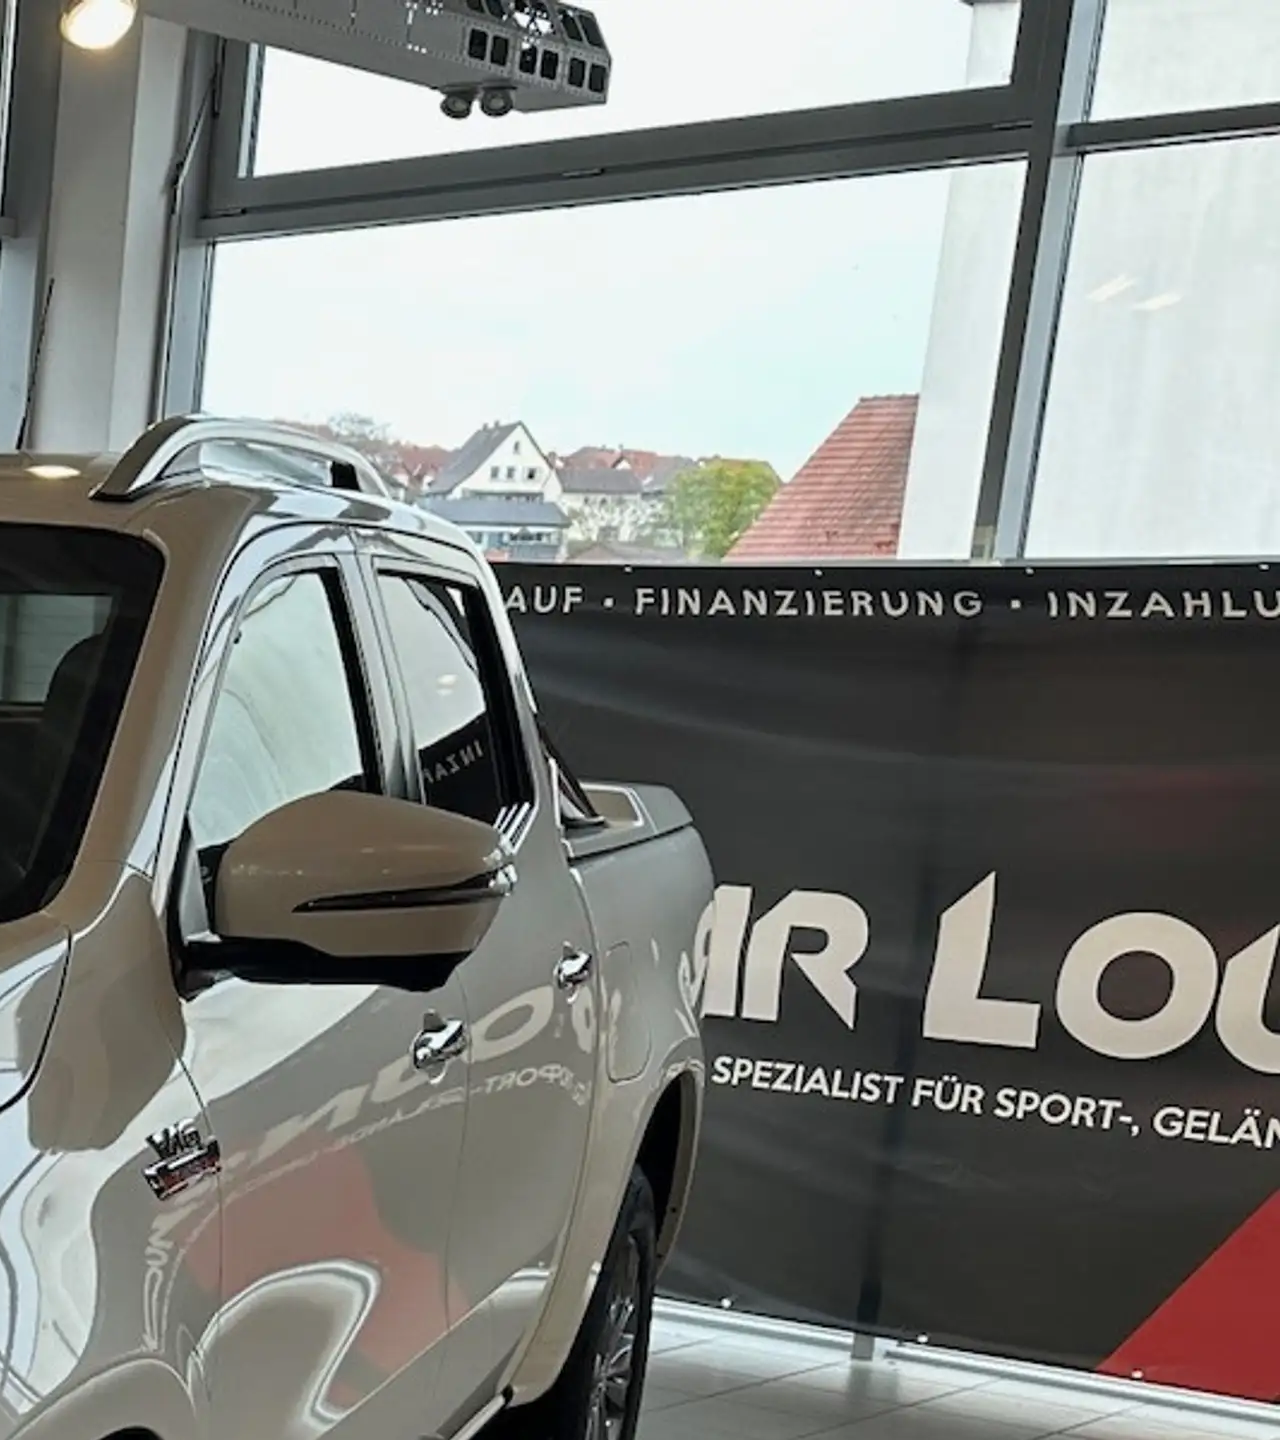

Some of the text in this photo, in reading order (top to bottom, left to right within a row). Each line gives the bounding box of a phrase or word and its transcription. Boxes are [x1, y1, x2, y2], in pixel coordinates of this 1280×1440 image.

[635, 588, 983, 618] FINANZIERUNG
[1047, 590, 1280, 619] INZAHLU
[711, 1056, 903, 1104] SPEZIALIST
[912, 1074, 984, 1115] FÜR
[993, 1088, 1140, 1136] SPORT-,
